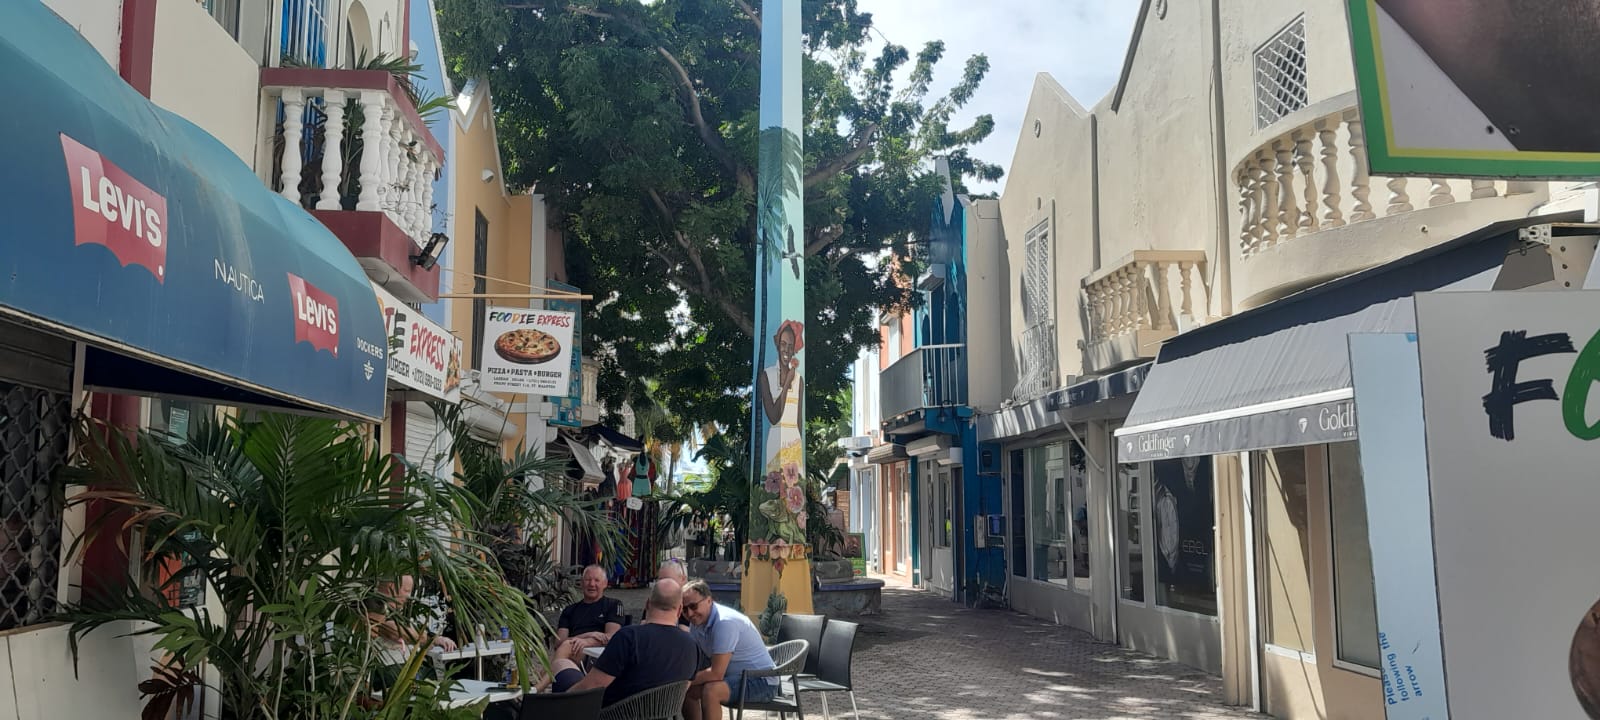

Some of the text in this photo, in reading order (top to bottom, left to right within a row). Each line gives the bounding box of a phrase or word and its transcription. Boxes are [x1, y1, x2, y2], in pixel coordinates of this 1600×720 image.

[81, 166, 162, 247] Levi's
[214, 258, 265, 304] NAUTICA
[297, 292, 337, 335] Levi's
[489, 311, 571, 328] FOODIE EXPRESS
[356, 337, 384, 360] DOCKERS
[410, 322, 446, 371] EXPRESS
[487, 367, 562, 379] PIZZA PASTA BURGER
[1138, 432, 1177, 458] Goldfinger
[1378, 632, 1410, 702] following the
[1404, 665, 1423, 697] arrow
